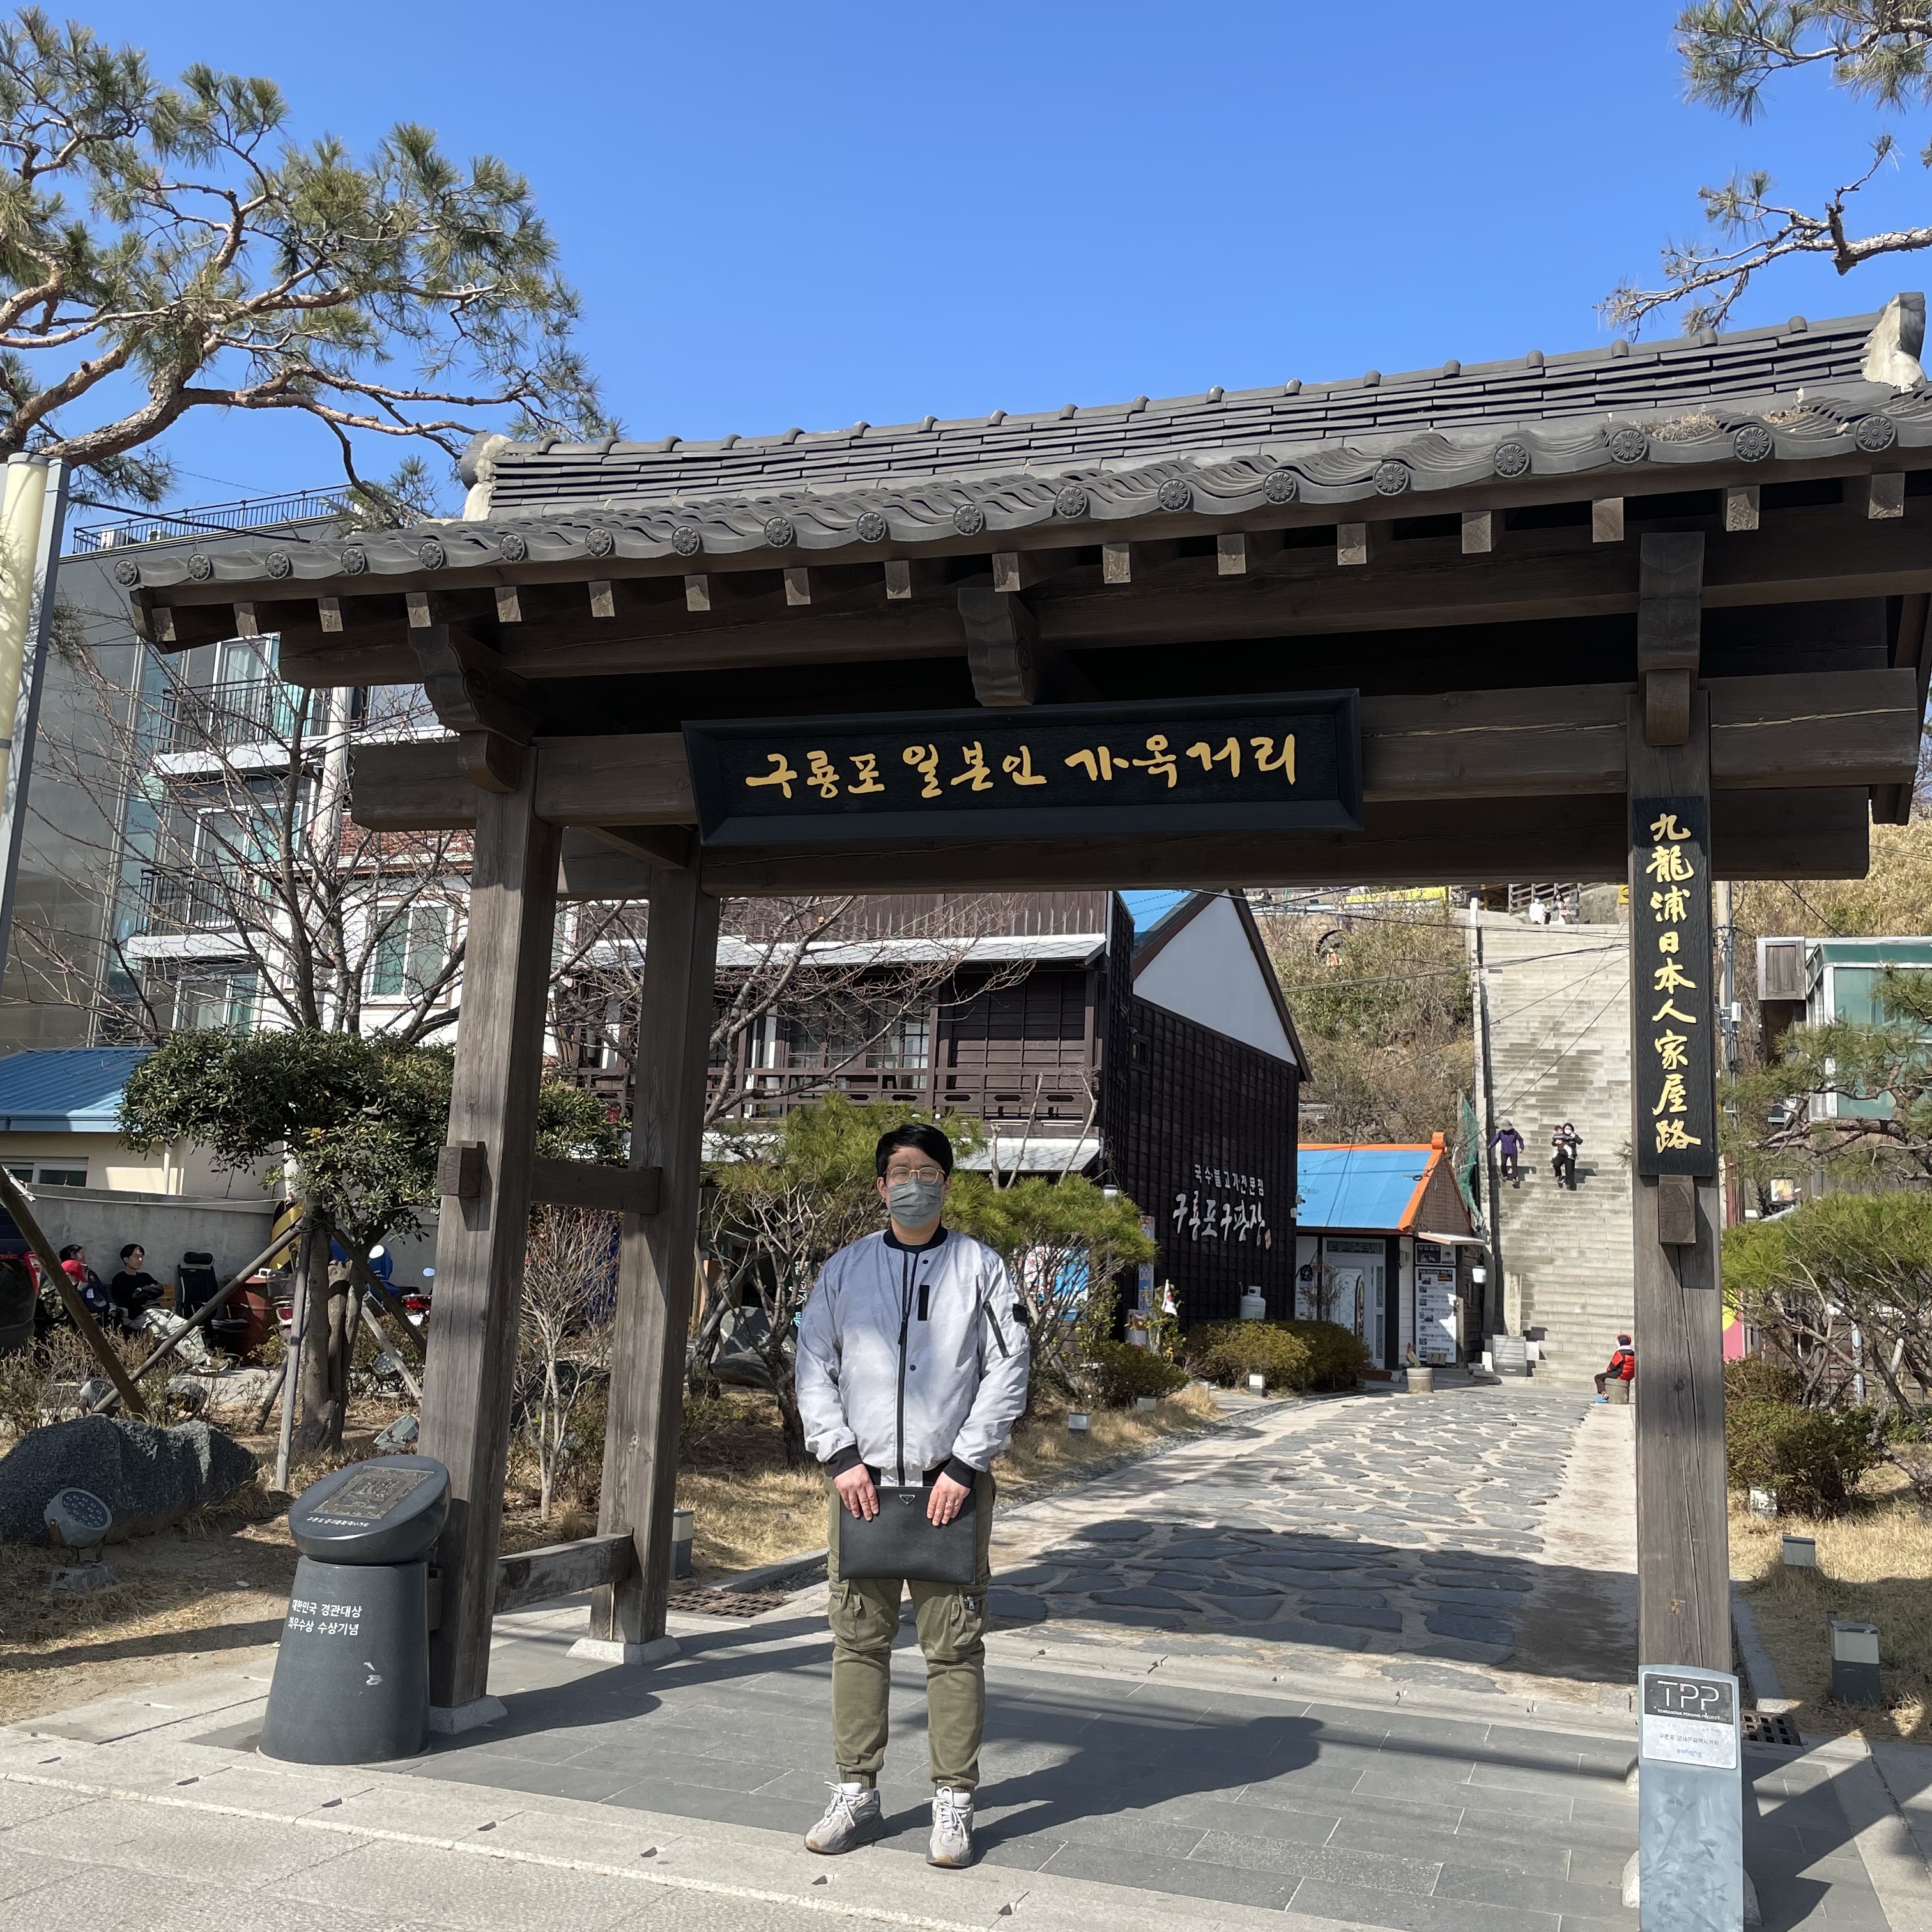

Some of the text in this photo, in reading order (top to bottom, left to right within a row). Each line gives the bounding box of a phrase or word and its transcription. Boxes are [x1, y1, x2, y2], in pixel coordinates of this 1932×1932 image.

[746, 734, 1296, 799] 구룡포 일본인 가옥거리
[1646, 813, 1701, 1154] 九龍浦日本人家屋路
[292, 1599, 363, 1618] 대한민국 경관대상
[288, 1616, 359, 1636] 최우수상 수상기념
[1657, 1680, 1719, 1711] TPP
